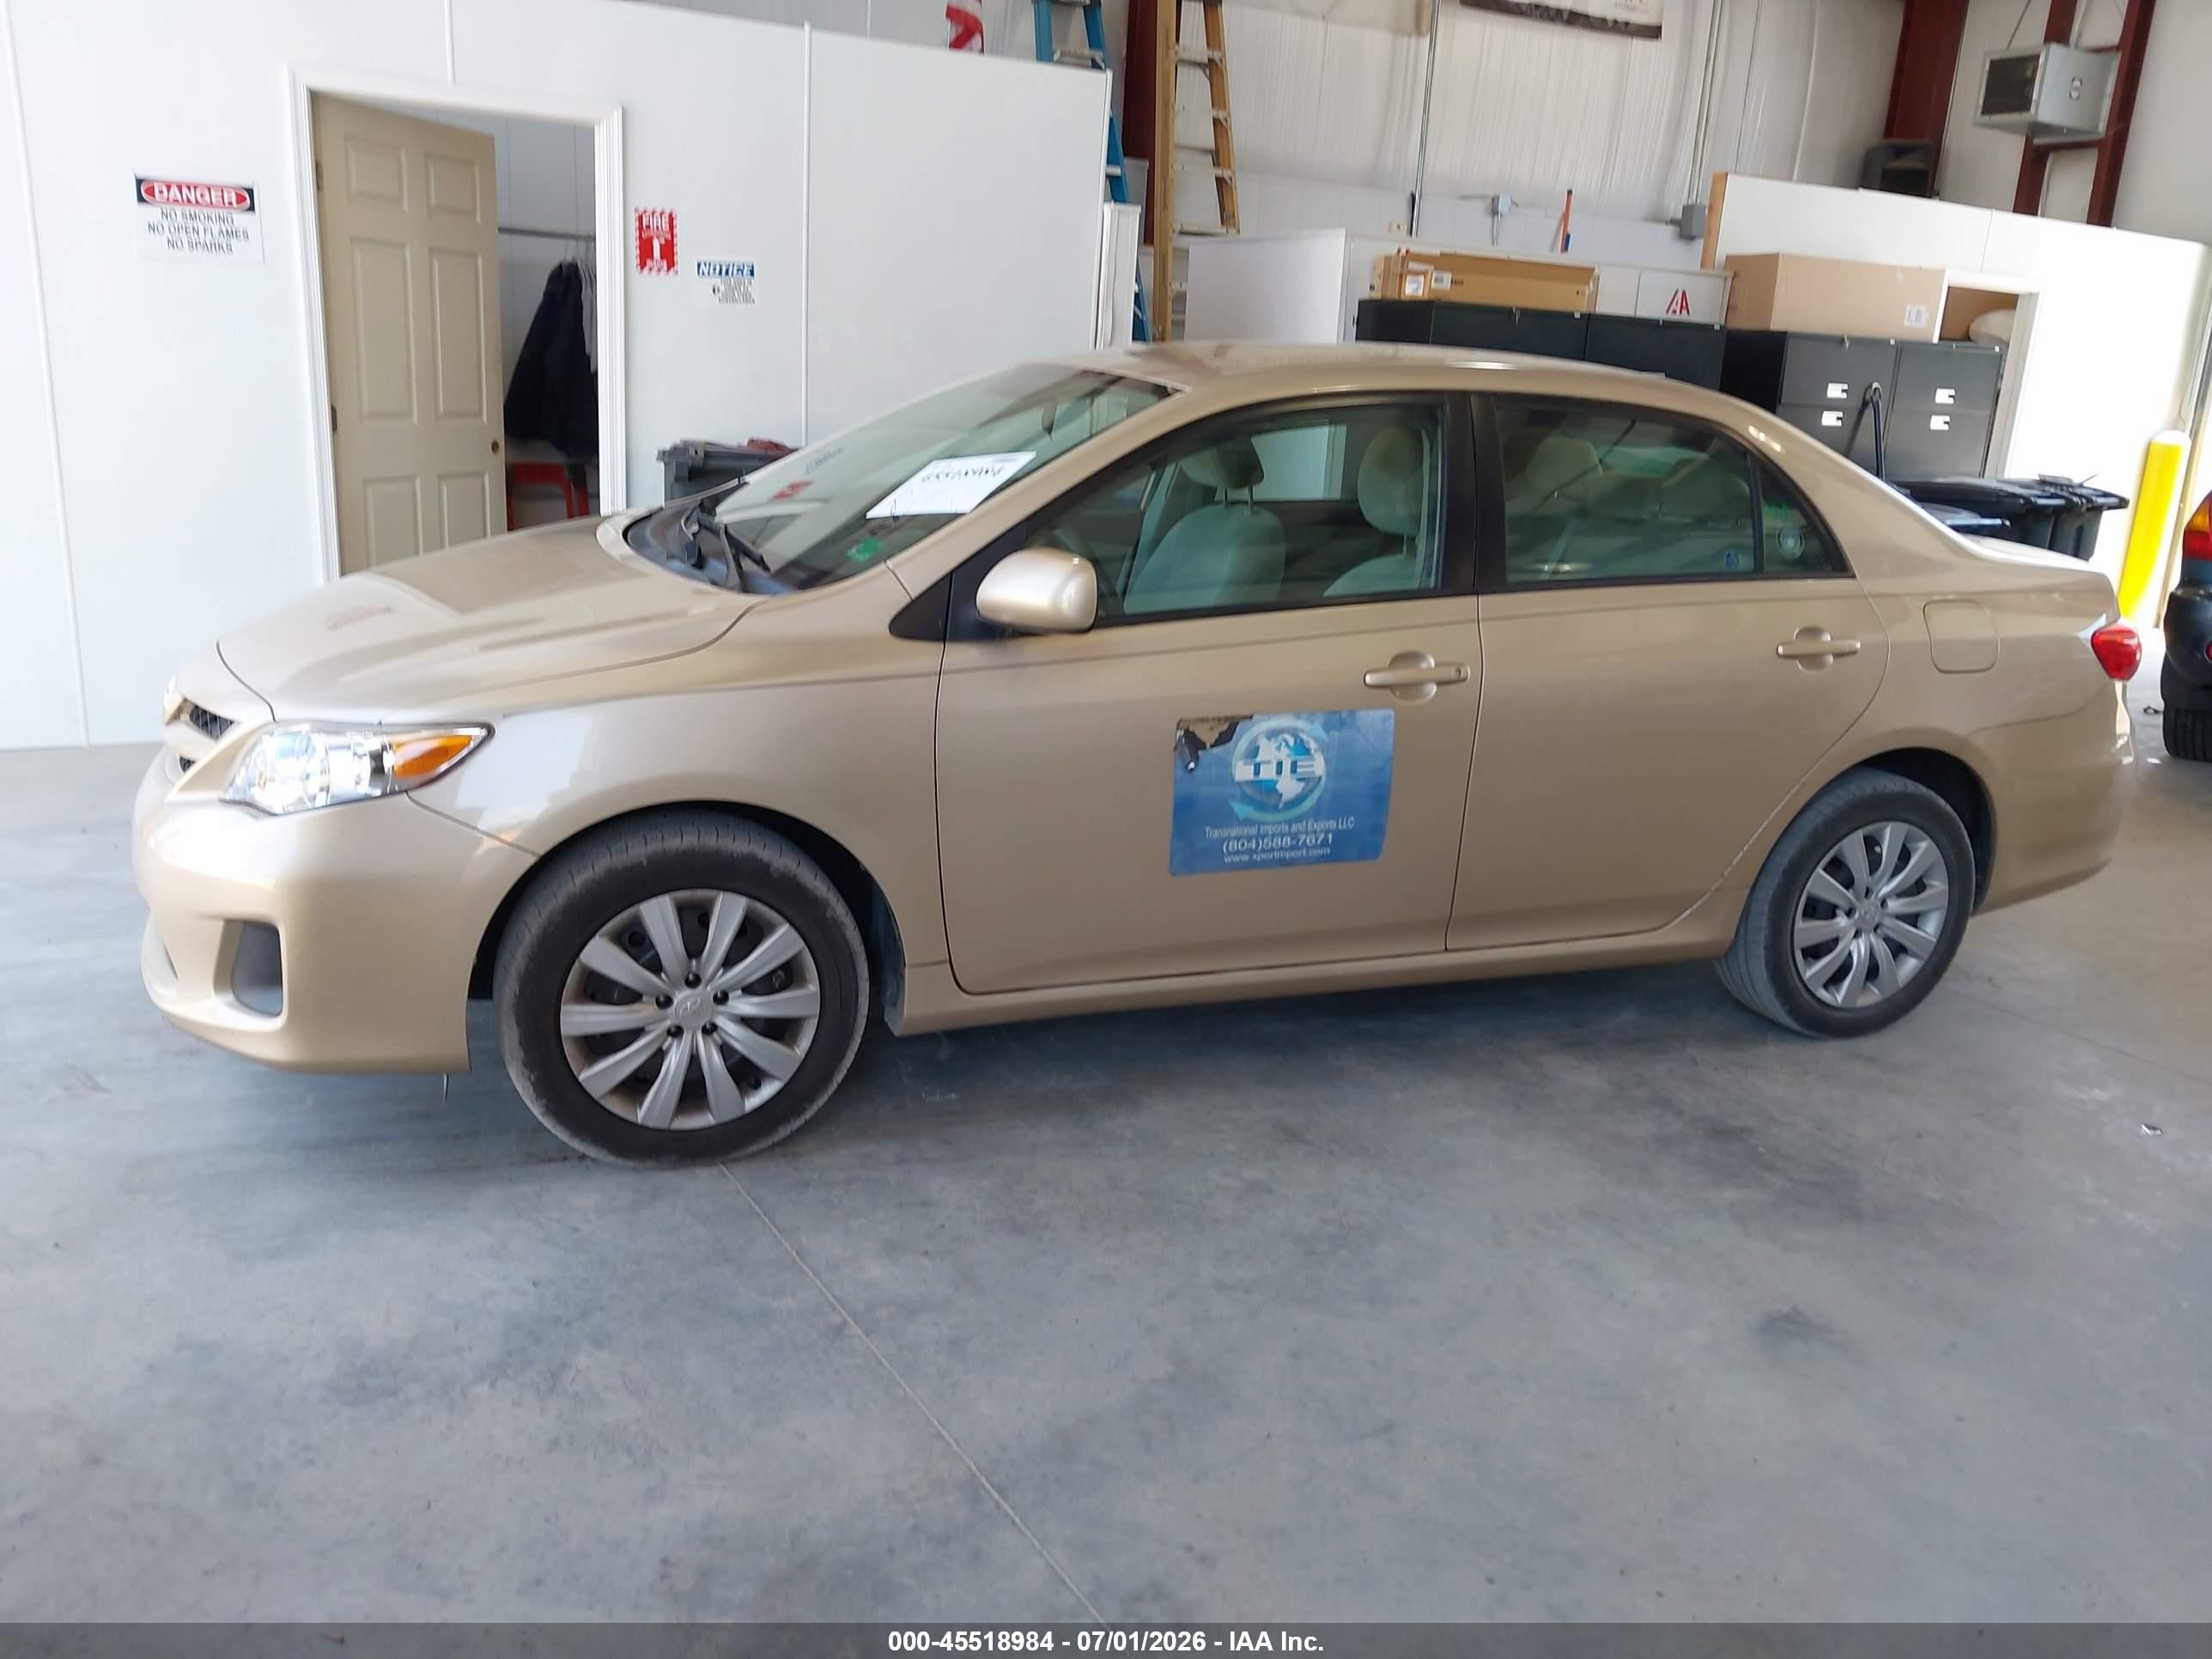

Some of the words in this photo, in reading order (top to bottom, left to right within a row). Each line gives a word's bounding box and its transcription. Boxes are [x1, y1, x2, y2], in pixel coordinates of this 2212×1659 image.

[153, 181, 237, 207] DANGER
[160, 207, 178, 221] NO
[181, 209, 234, 226] SMOKING
[642, 213, 670, 232] FIRE
[147, 221, 165, 235] NO
[168, 222, 200, 237] OPEN
[204, 225, 250, 241] FLAMES
[167, 236, 185, 251] NO
[187, 239, 234, 254] SPARKS
[699, 261, 753, 277] NOTICE
[1204, 824, 1259, 839] Transnational
[1260, 823, 1290, 836] Imports
[1291, 820, 1306, 833] and
[1308, 817, 1338, 832] Exports
[1338, 815, 1355, 830] LLC
